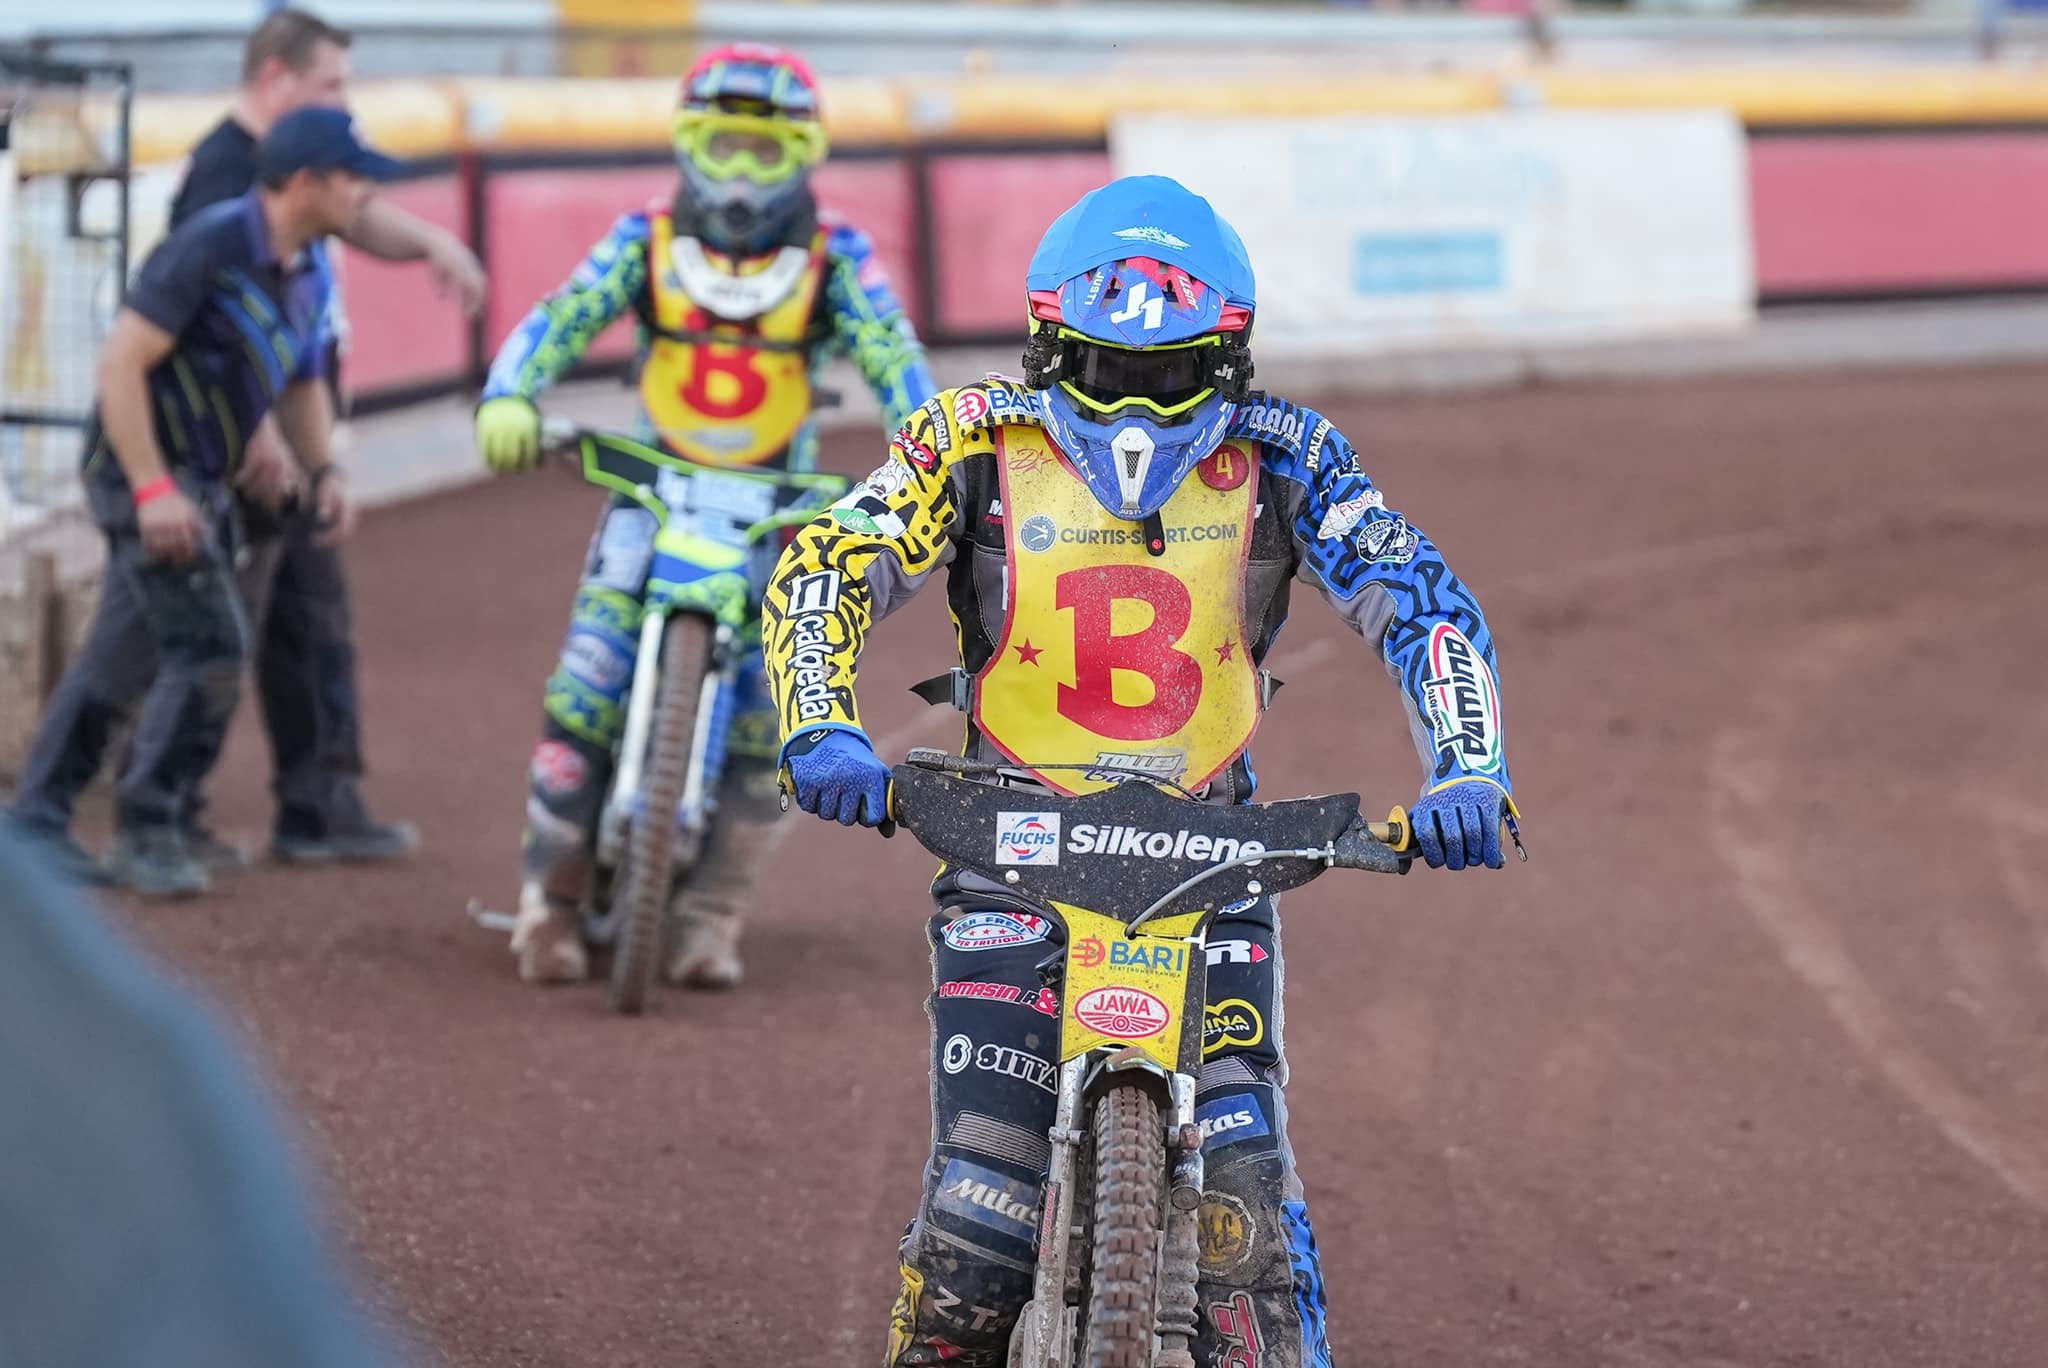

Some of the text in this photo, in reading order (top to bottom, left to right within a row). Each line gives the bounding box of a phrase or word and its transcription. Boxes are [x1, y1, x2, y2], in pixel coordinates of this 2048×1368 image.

[679, 306, 768, 419] B
[1215, 452, 1234, 481] 4
[1060, 523, 1238, 545] CURTIS-SRT.COM
[787, 612, 839, 721] calpeda
[1055, 563, 1204, 742] B
[1000, 831, 1057, 846] FUCHS
[1066, 823, 1266, 867] Silkolene
[1109, 941, 1185, 972] BARI
[1093, 993, 1151, 1017] JAWA
[1199, 1109, 1254, 1139] tas
